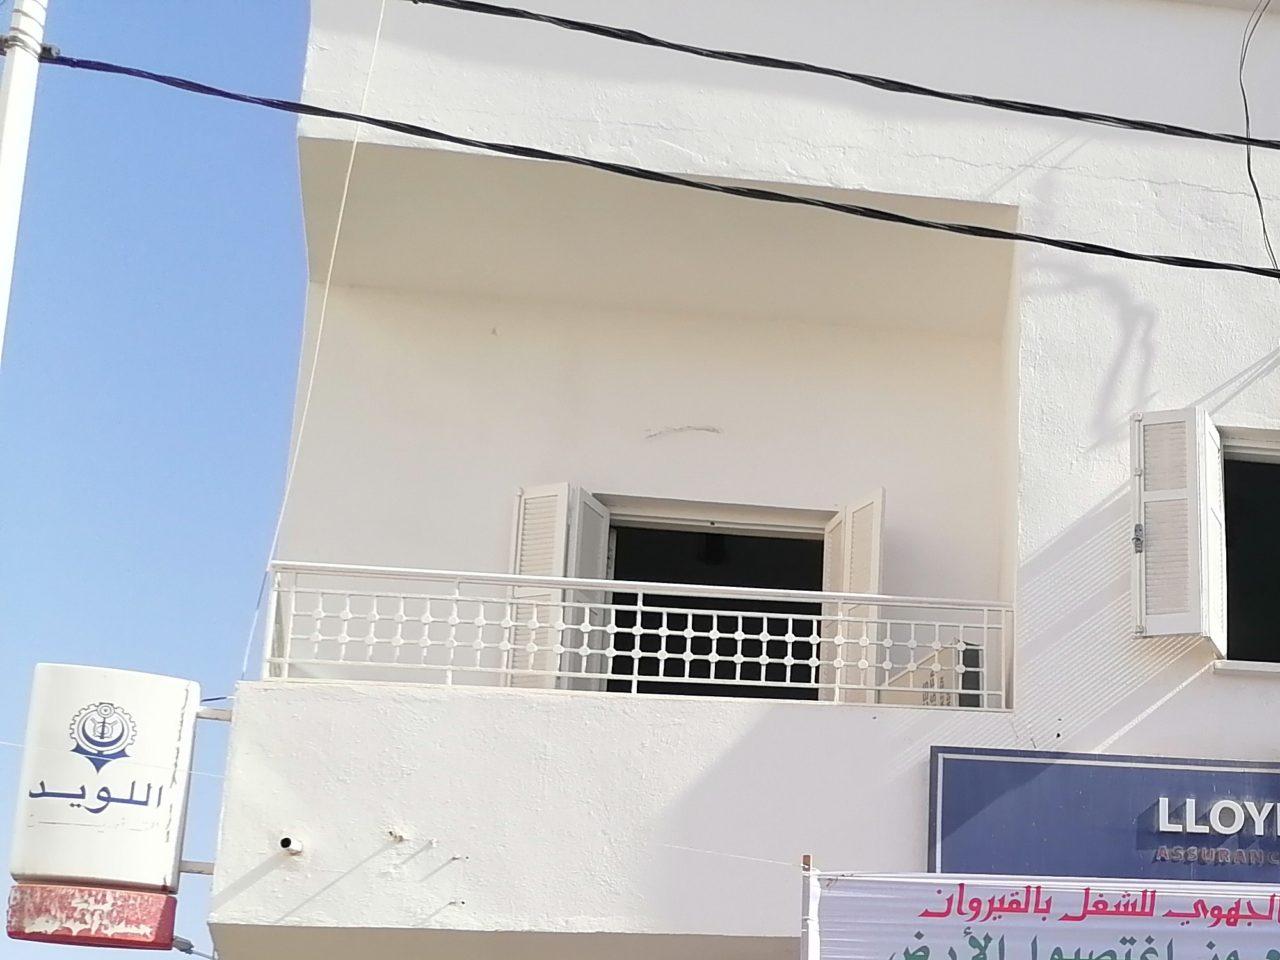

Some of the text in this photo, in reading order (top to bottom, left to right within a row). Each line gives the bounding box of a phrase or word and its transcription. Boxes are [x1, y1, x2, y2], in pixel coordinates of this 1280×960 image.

[28, 780, 163, 814] اللويد
[918, 883, 1053, 922] بالقيروان
[1056, 881, 1160, 921] للشغل
